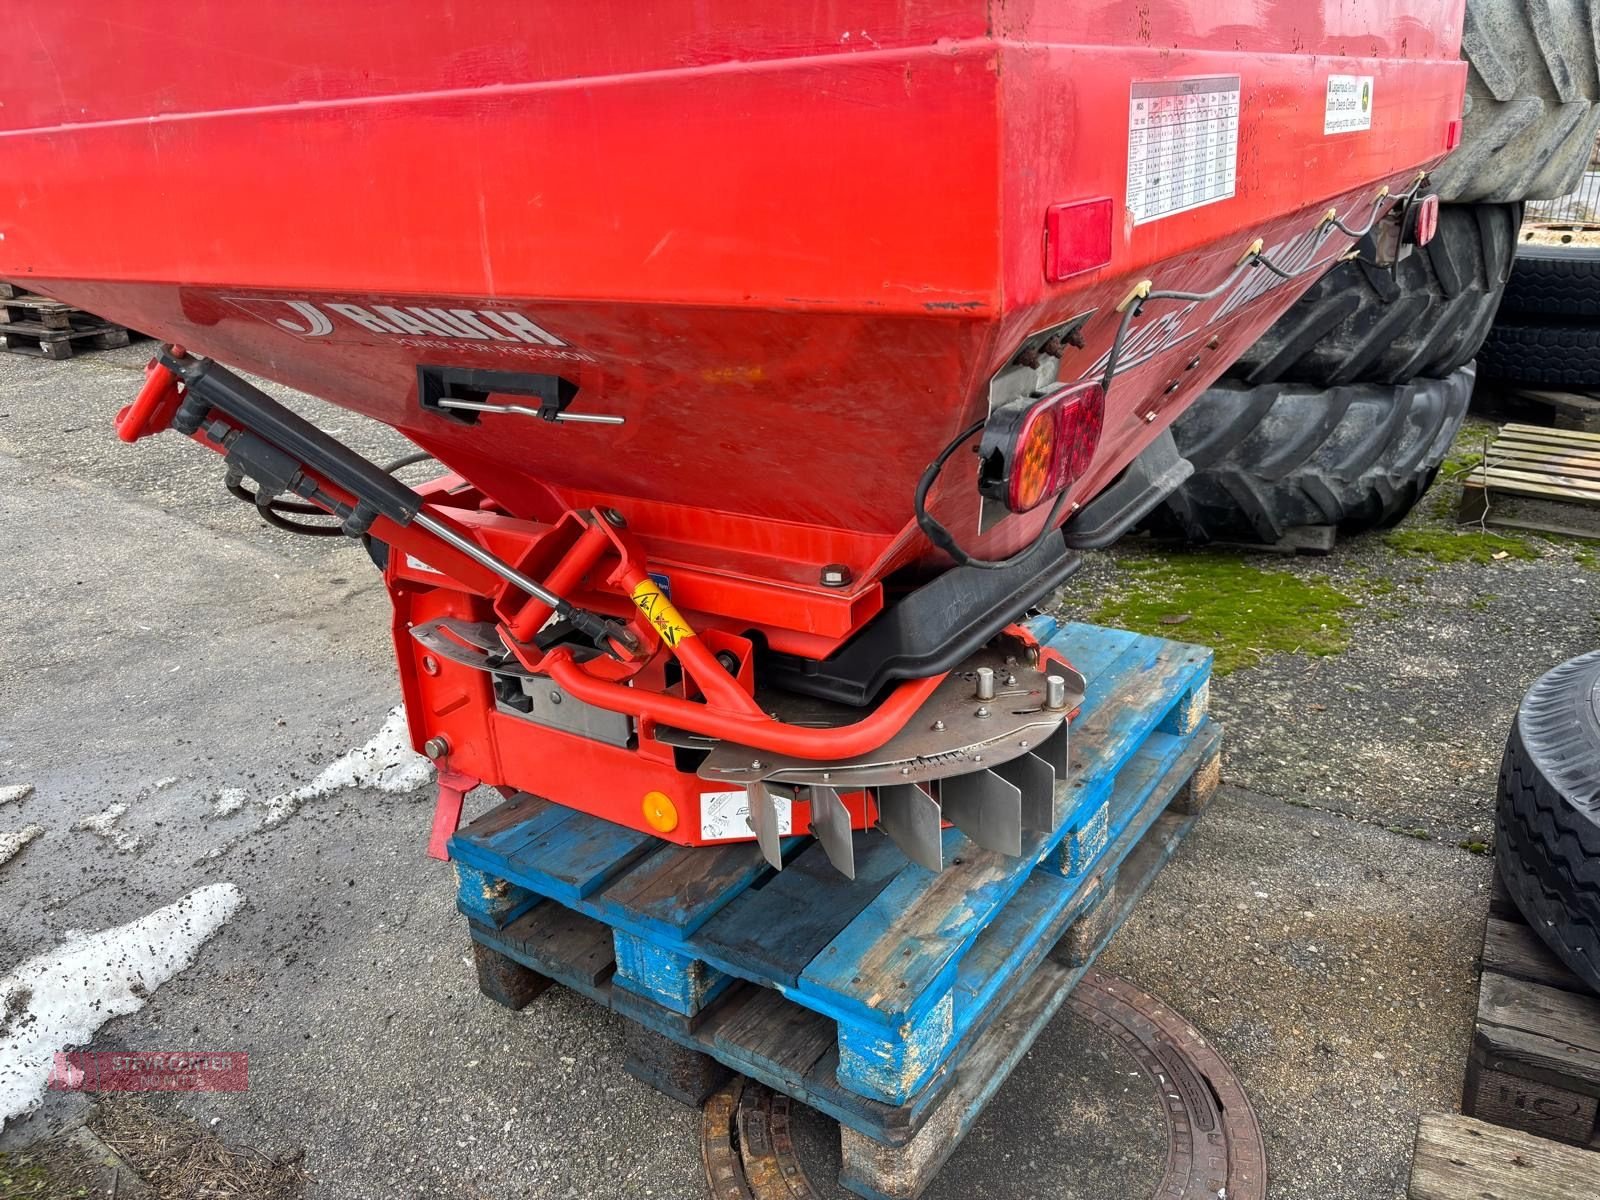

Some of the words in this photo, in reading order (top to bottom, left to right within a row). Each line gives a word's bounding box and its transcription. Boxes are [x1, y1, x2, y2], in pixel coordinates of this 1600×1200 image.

[325, 303, 570, 346] RAUCH
[391, 337, 449, 349] POWER
[453, 341, 490, 352] FOR
[495, 345, 599, 362] PRECISION
